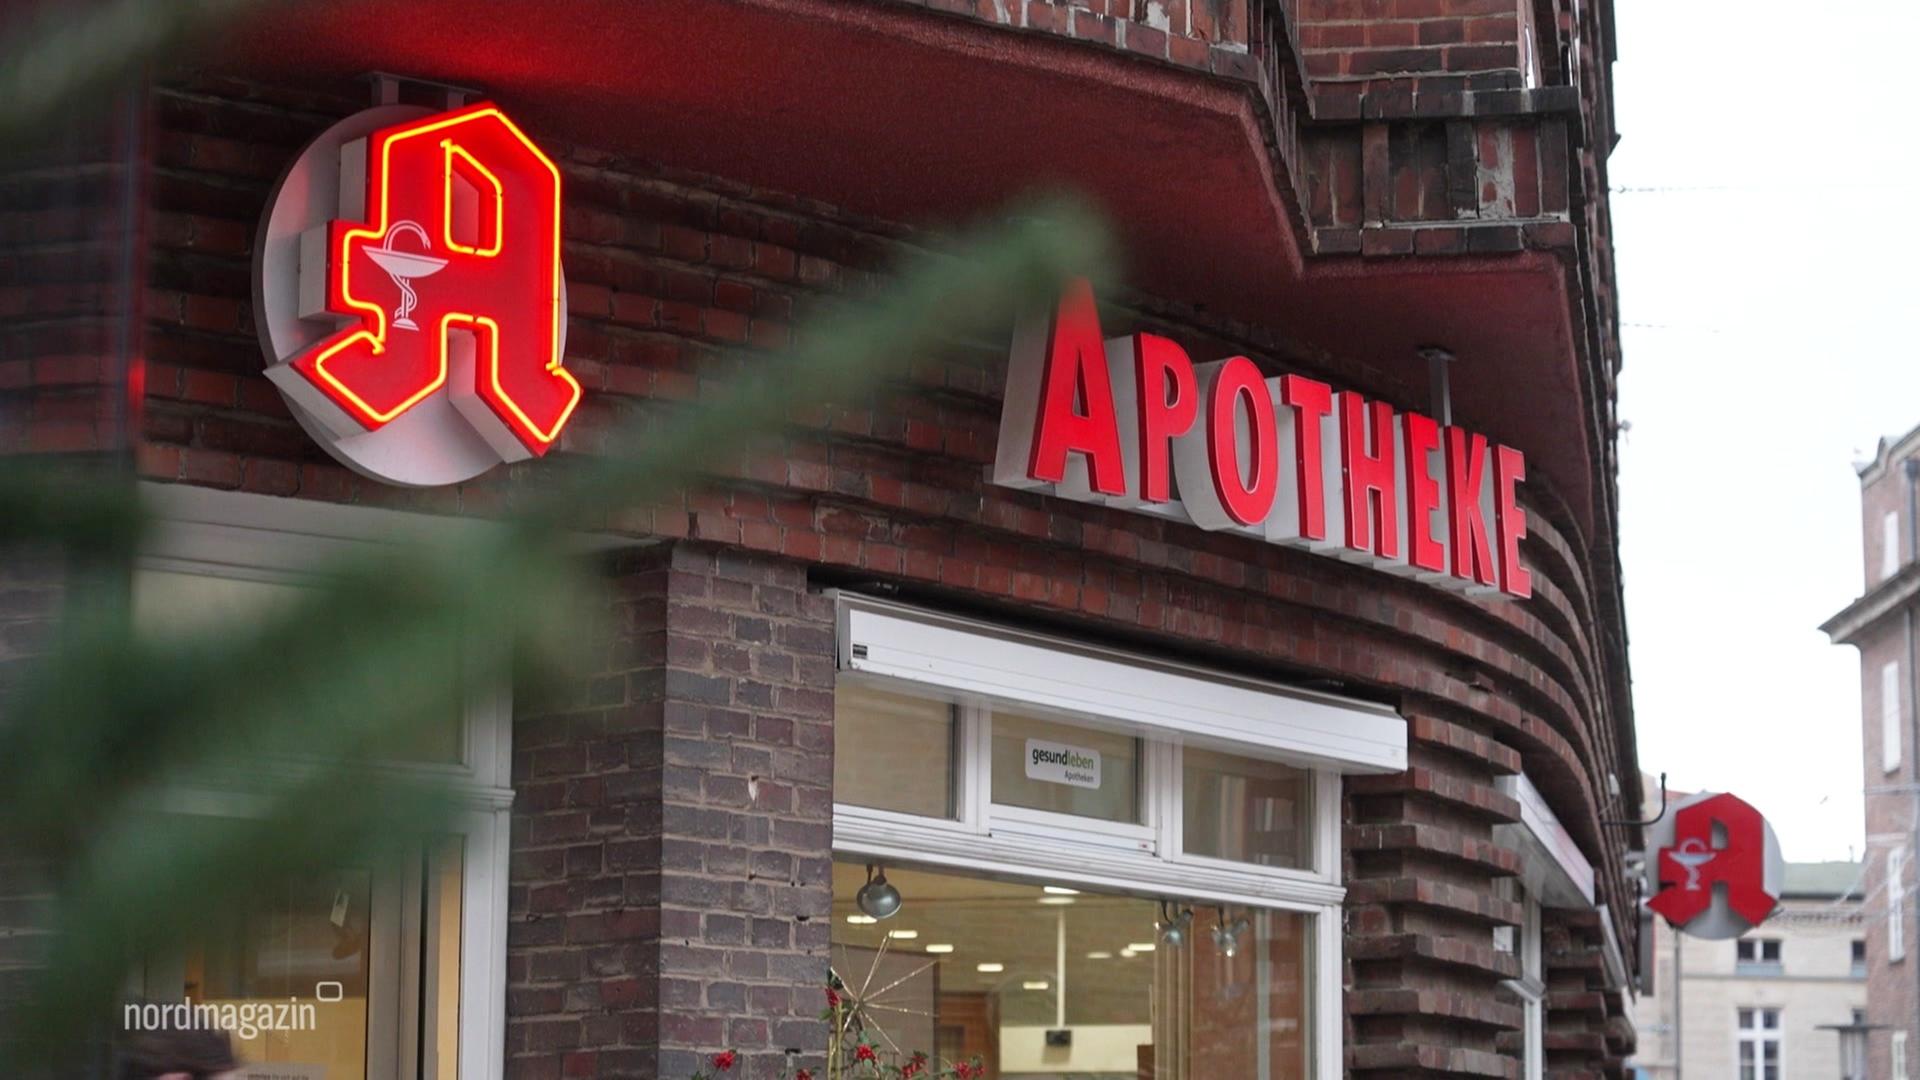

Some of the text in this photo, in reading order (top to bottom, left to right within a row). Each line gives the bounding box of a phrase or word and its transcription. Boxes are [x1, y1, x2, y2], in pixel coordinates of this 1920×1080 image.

[1027, 277, 1532, 598] APOTHEKE
[1032, 747, 1094, 769] gesundleben
[1064, 770, 1094, 782] Apotheken
